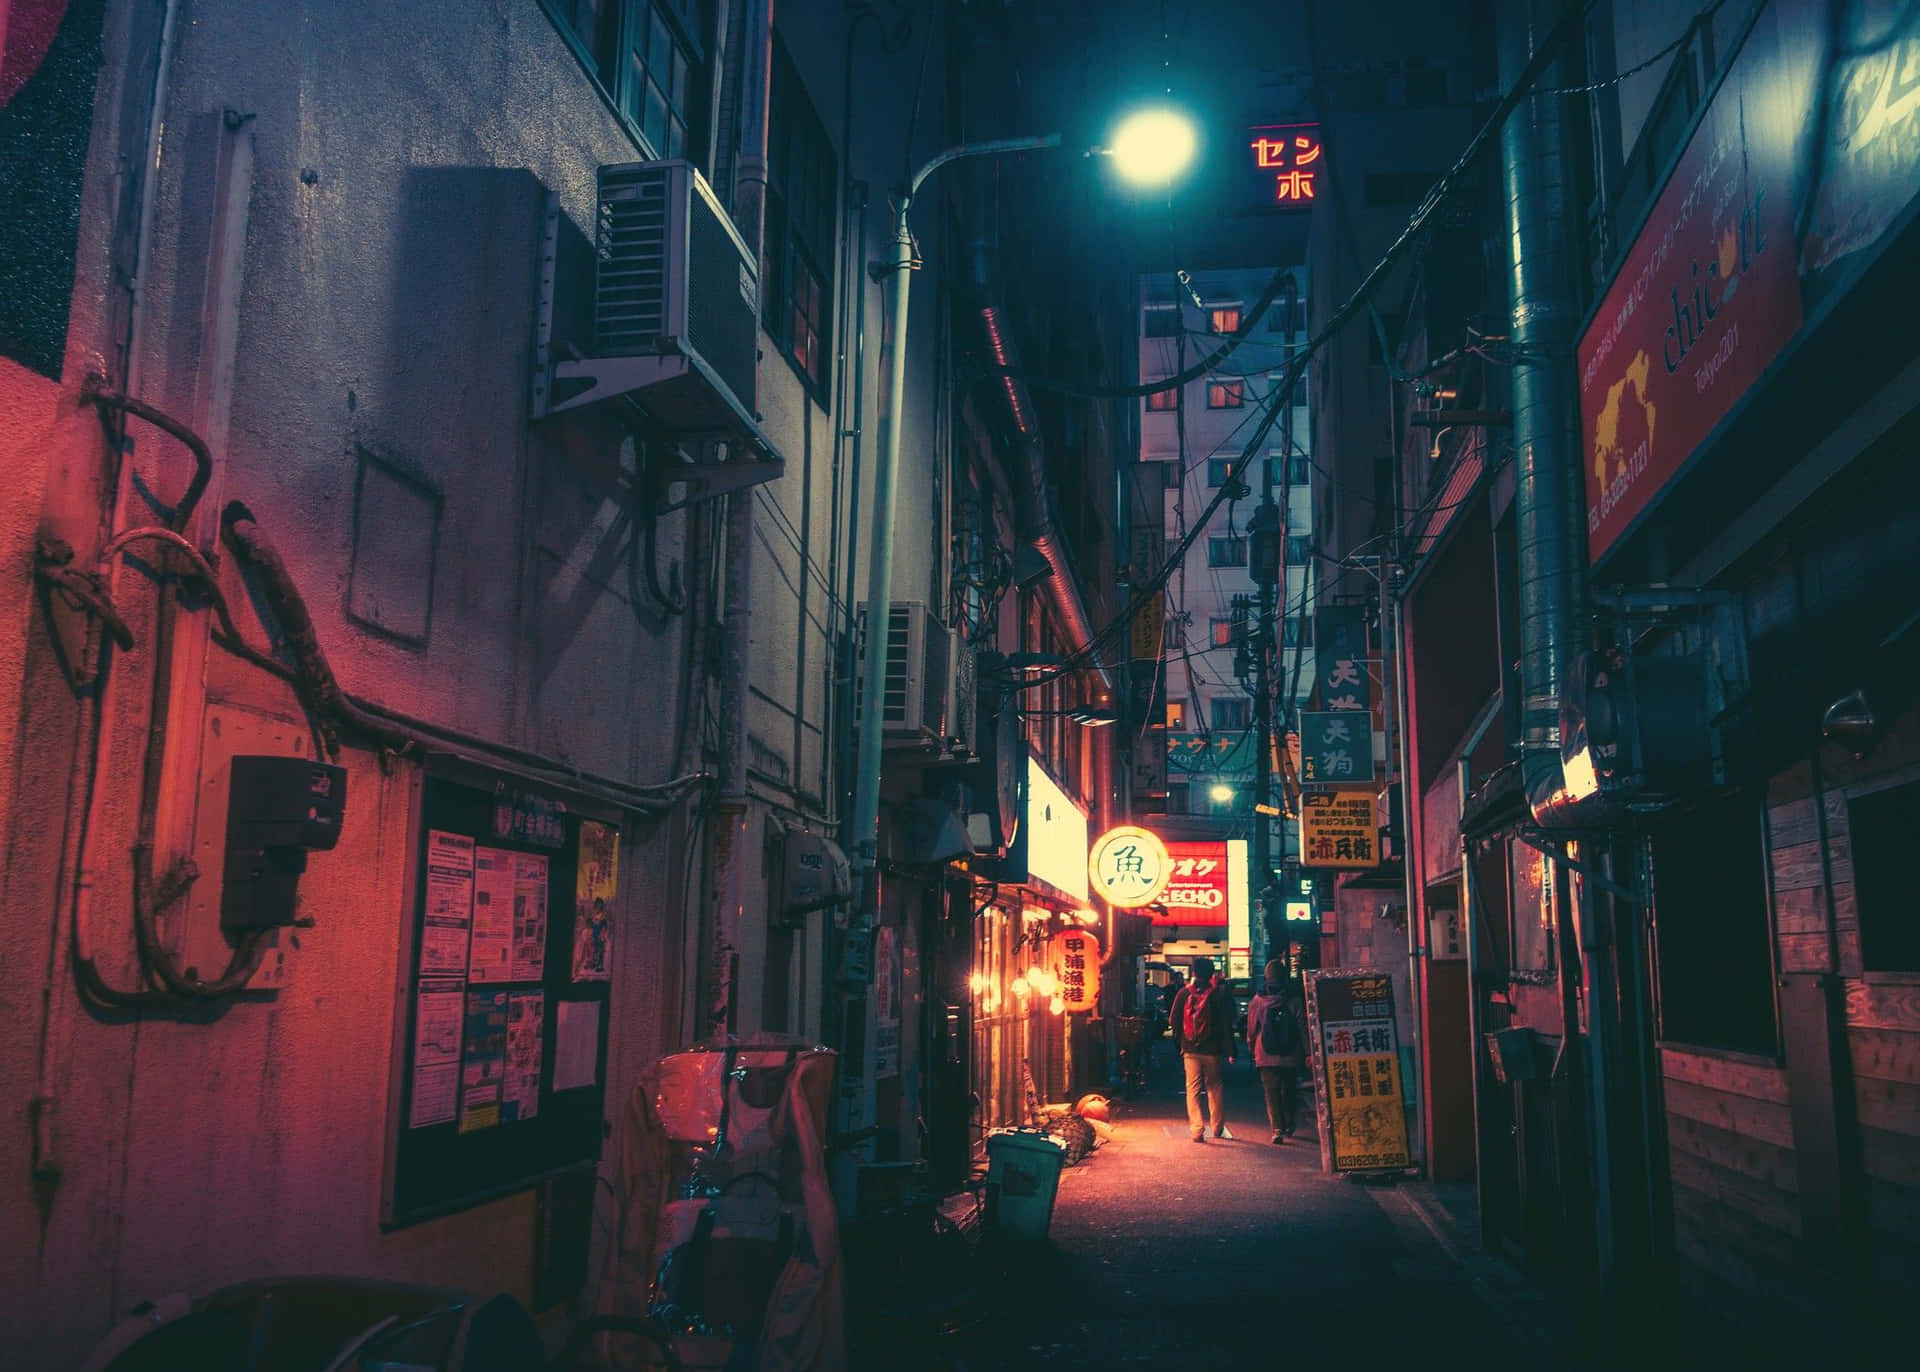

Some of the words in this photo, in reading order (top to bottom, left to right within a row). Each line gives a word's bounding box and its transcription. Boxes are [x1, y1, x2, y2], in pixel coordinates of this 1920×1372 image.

[1107, 845, 1153, 886] 魚
[1171, 889, 1223, 907] ECHO
[1063, 938, 1085, 1002] 甲浦漁港
